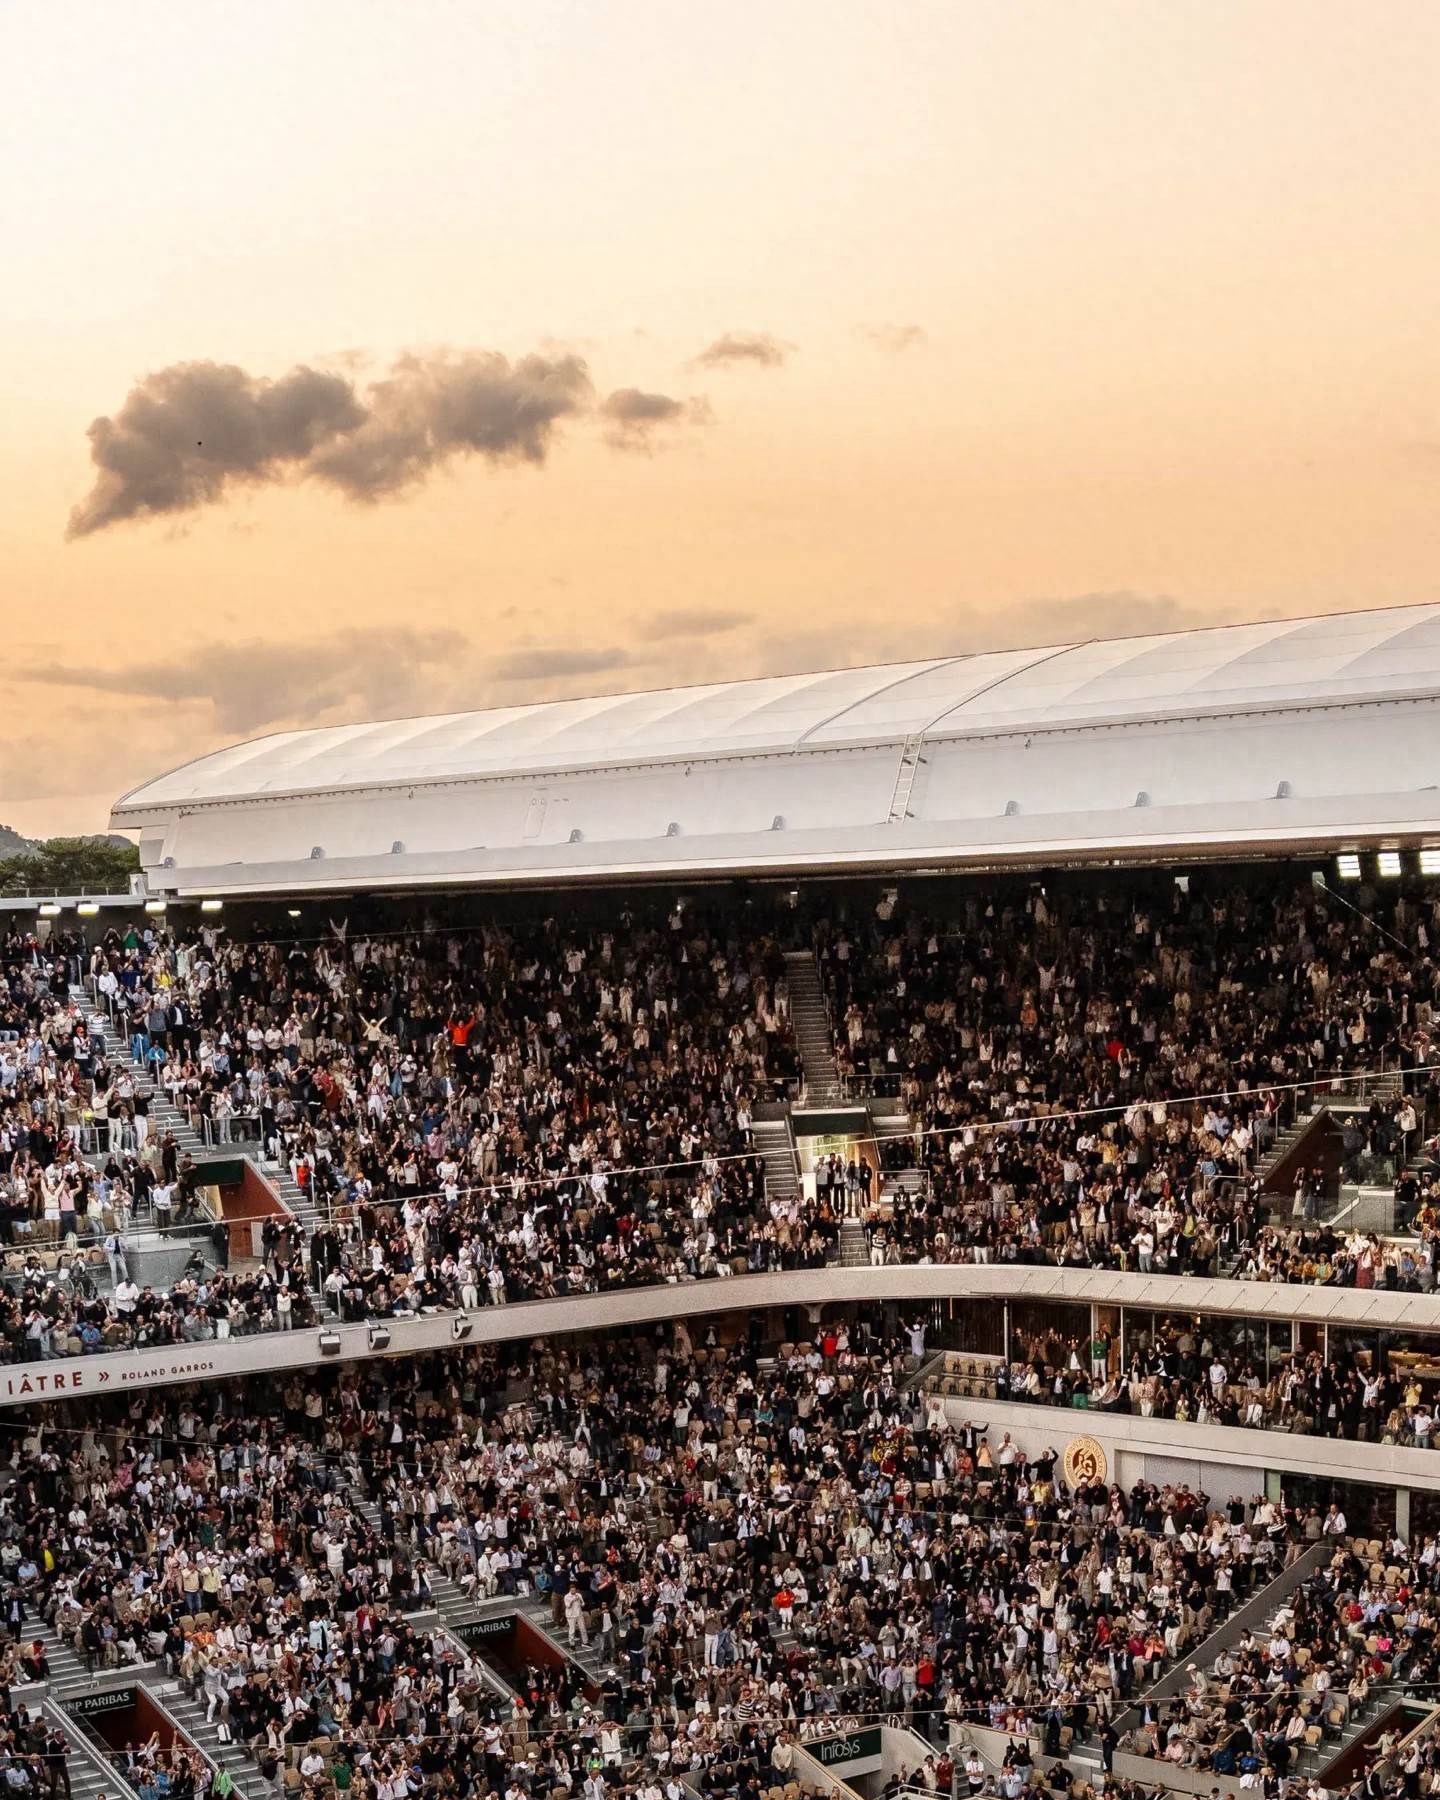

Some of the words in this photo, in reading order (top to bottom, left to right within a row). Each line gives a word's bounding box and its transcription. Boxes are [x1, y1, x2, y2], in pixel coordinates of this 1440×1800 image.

[121, 1368, 166, 1381] ROLAND
[171, 1361, 214, 1374] GARROS
[472, 1620, 511, 1635] PARIBAS
[84, 1692, 130, 1709] PARIBAS
[821, 1739, 861, 1761] Infosys
